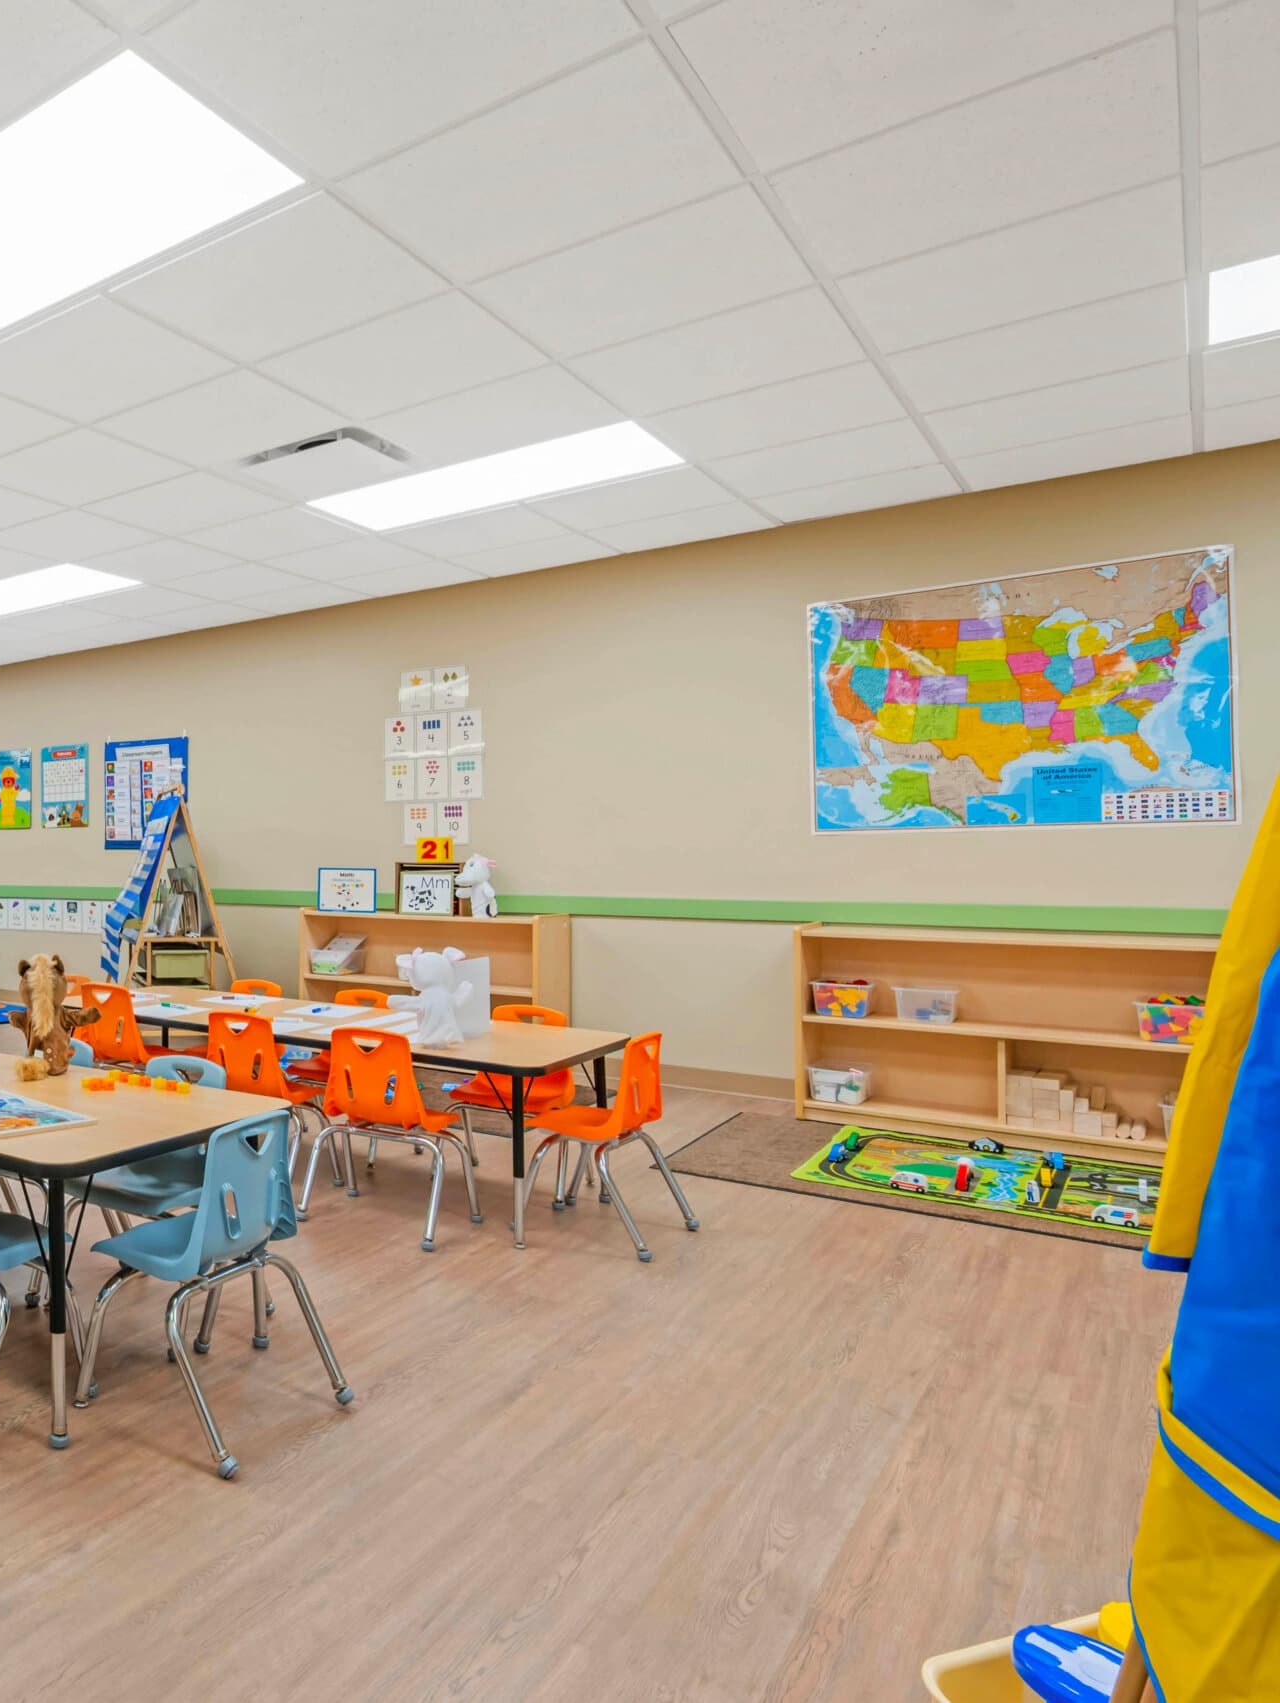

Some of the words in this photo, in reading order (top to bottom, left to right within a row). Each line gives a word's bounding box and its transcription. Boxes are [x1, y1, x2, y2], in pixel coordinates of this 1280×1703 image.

[395, 735, 402, 746] 3
[428, 733, 435, 744] 4
[463, 730, 470, 741] 5
[1036, 767, 1066, 775] United
[1068, 766, 1098, 774] States
[396, 780, 403, 789] 6
[429, 777, 436, 787] 7
[463, 775, 470, 786] 8
[416, 822, 422, 832] 9
[449, 821, 460, 832] 10
[421, 876, 450, 889] Mm
